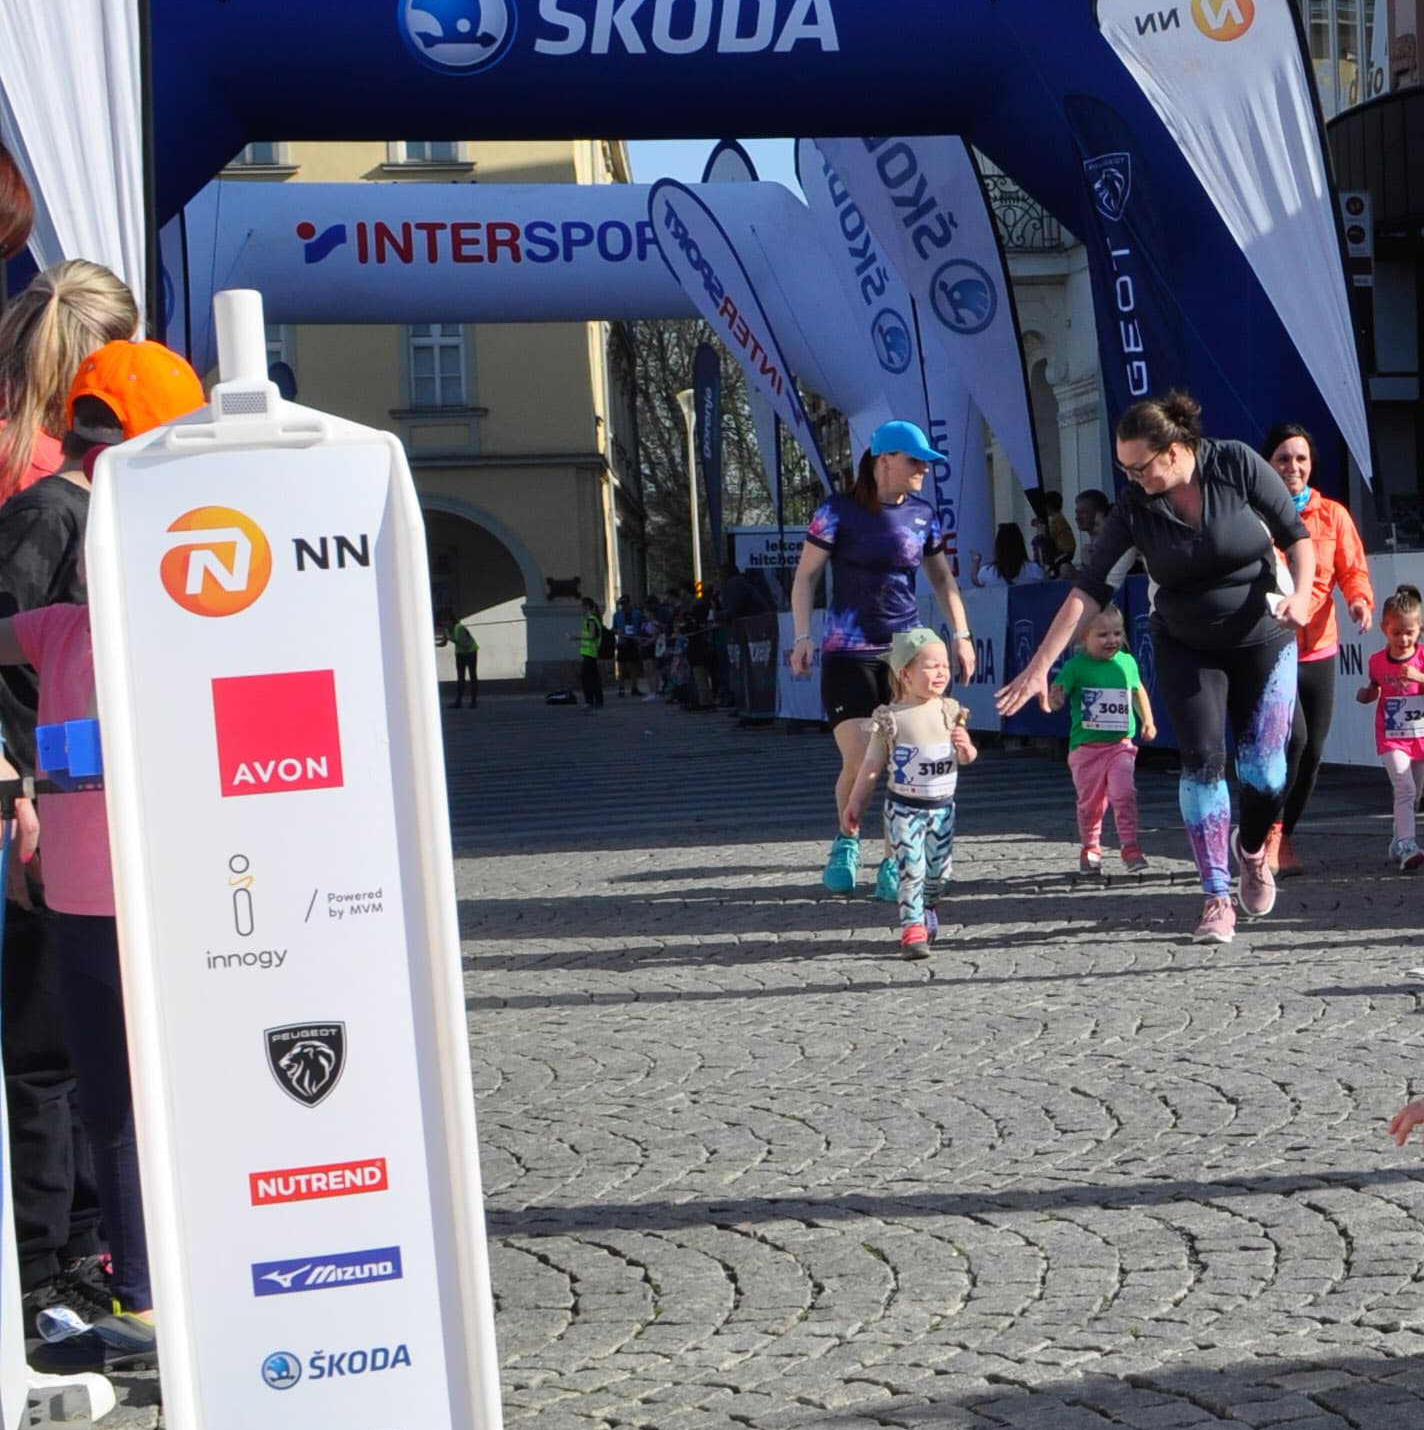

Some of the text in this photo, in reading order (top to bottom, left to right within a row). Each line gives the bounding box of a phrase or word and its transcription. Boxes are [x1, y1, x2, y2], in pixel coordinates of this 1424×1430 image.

[291, 533, 371, 572] NN
[1339, 643, 1364, 676] NN
[232, 756, 329, 786] AVON
[918, 760, 953, 776] 3187
[327, 888, 383, 905] Powered
[328, 902, 384, 920] by MVM
[206, 948, 288, 970] innogy
[271, 1027, 339, 1043] PEUGEOT
[256, 1166, 382, 1199] NUTREND
[307, 1343, 412, 1381] ŠKODA
